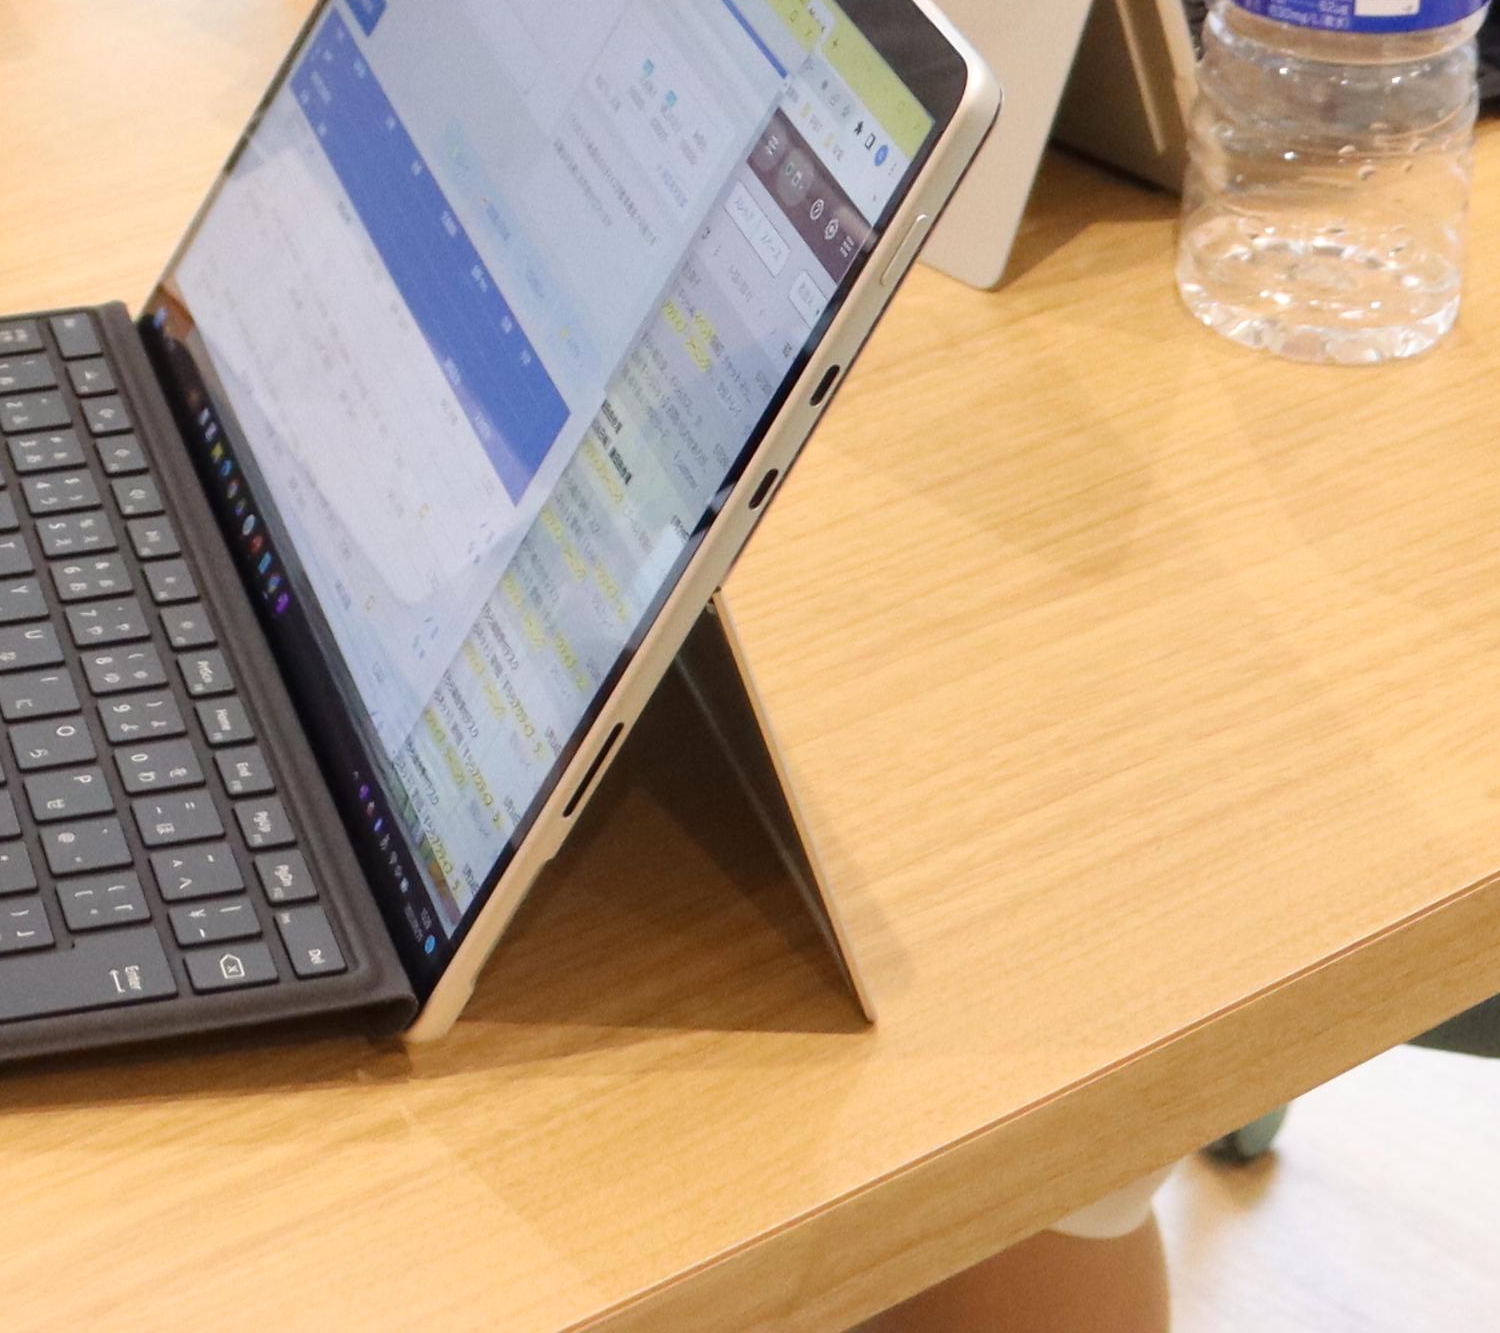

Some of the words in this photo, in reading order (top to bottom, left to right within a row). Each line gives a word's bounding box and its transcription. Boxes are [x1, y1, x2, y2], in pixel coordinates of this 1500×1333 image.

[10, 585, 29, 594] Y
[24, 629, 44, 639] U
[95, 656, 113, 665] 8
[112, 704, 131, 713] 9
[235, 761, 252, 777] End
[73, 774, 93, 784] P
[308, 948, 325, 965] Del
[124, 964, 142, 990] Enter
